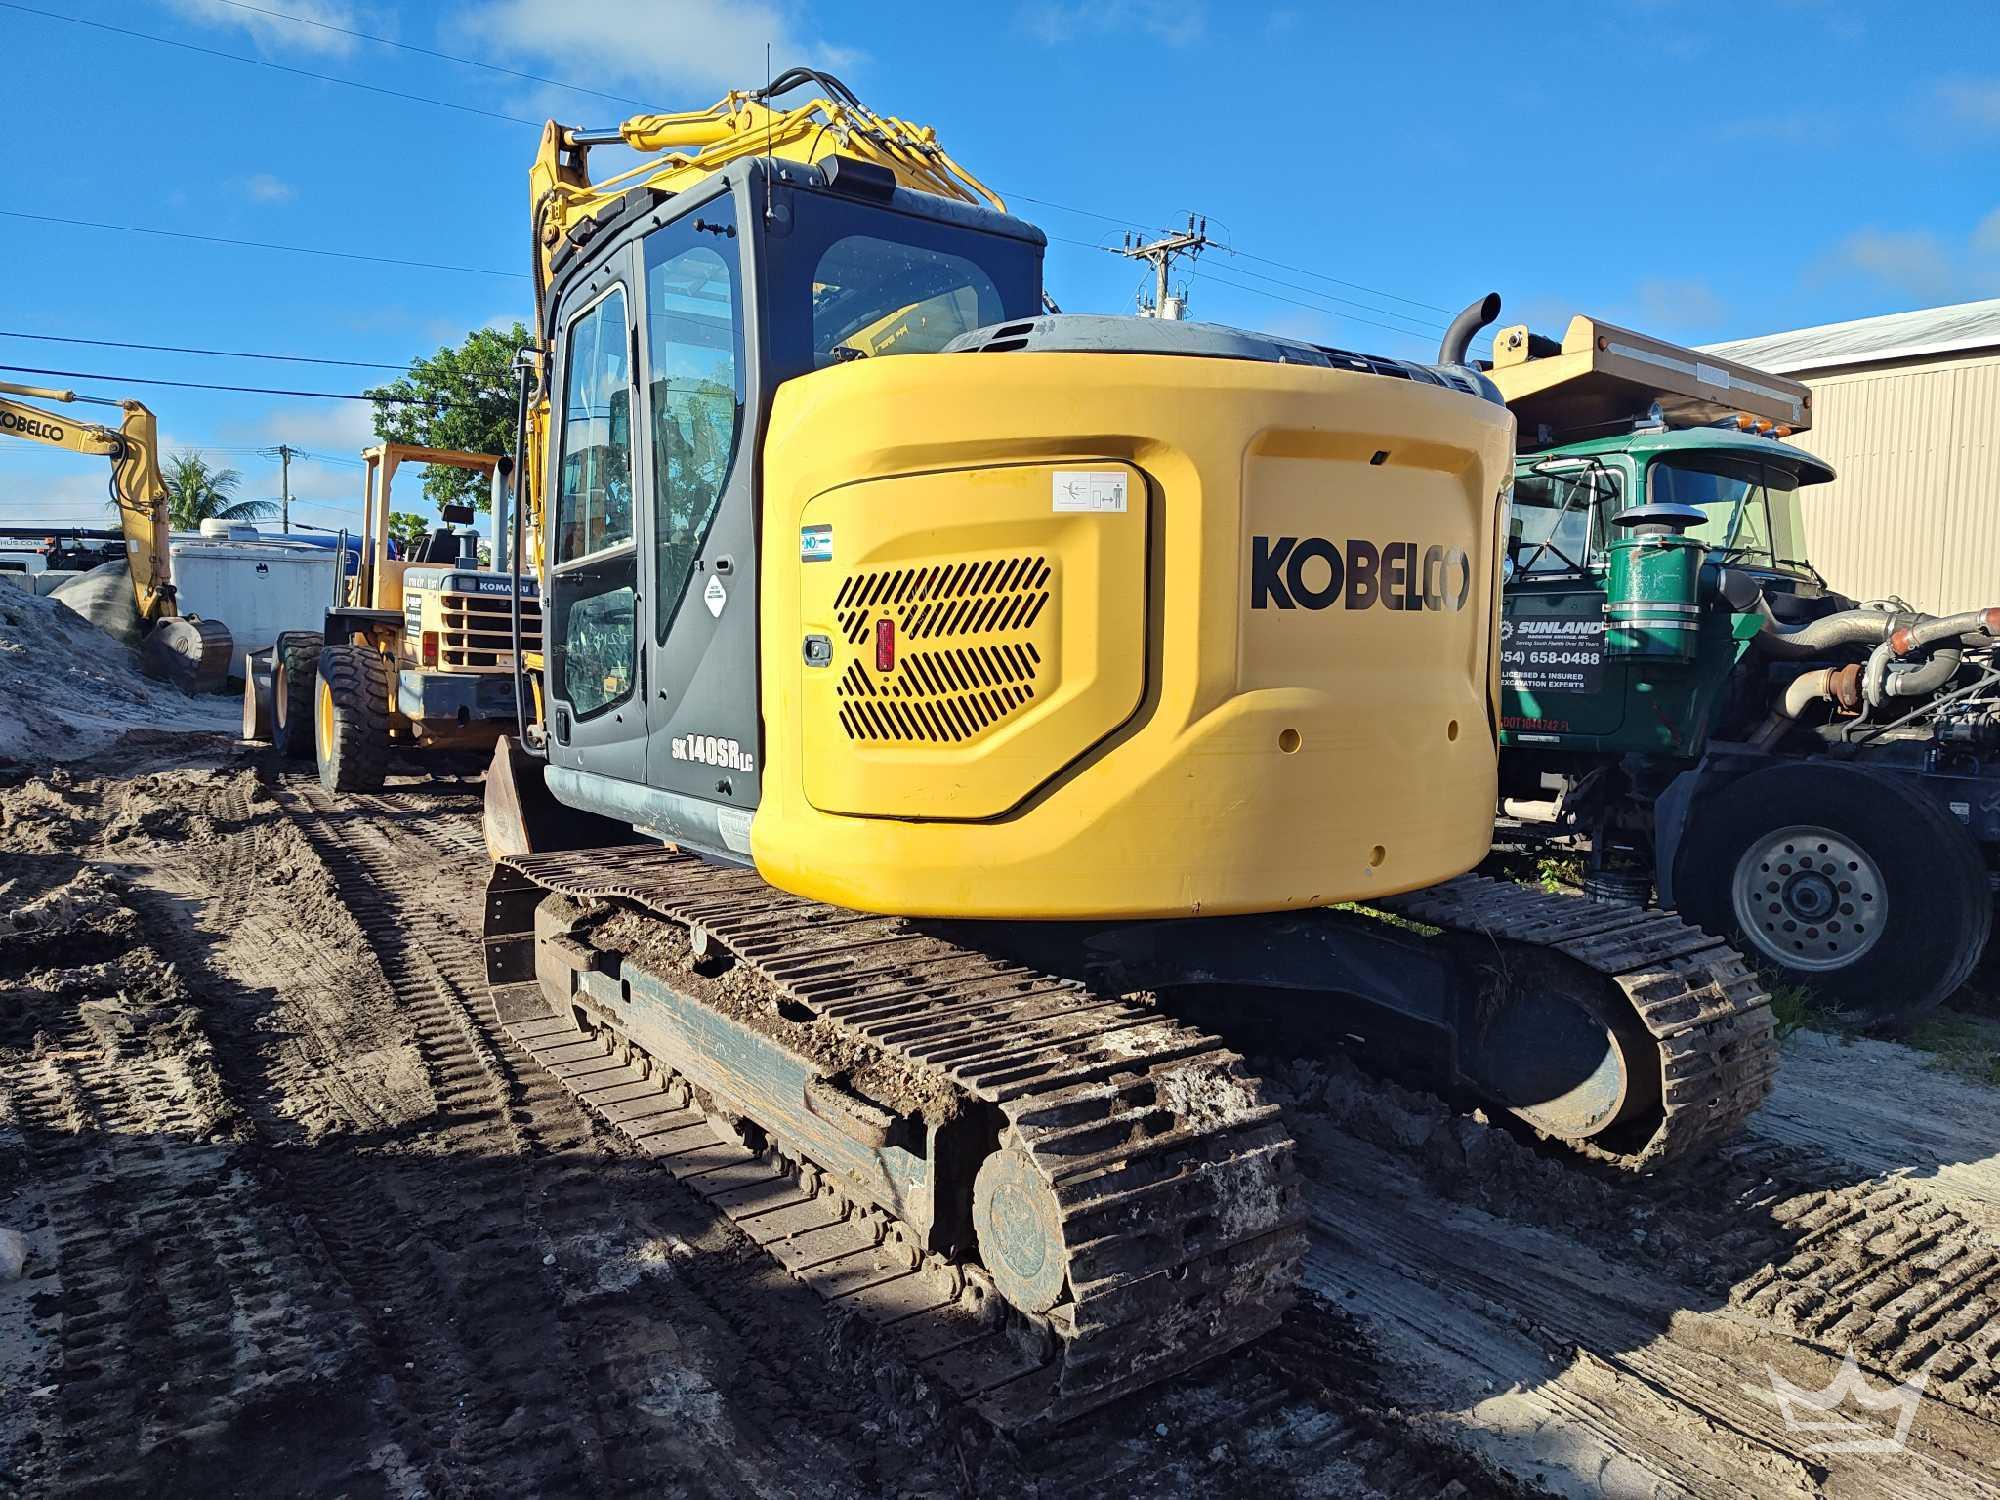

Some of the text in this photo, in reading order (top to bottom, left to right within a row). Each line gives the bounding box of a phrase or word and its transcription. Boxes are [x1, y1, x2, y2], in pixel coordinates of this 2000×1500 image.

[1251, 536, 1471, 612] KOBELCO
[1517, 621, 1602, 634] SUNLAND
[1529, 651, 1600, 665] 658-0488
[1548, 672, 1584, 680] INSURED
